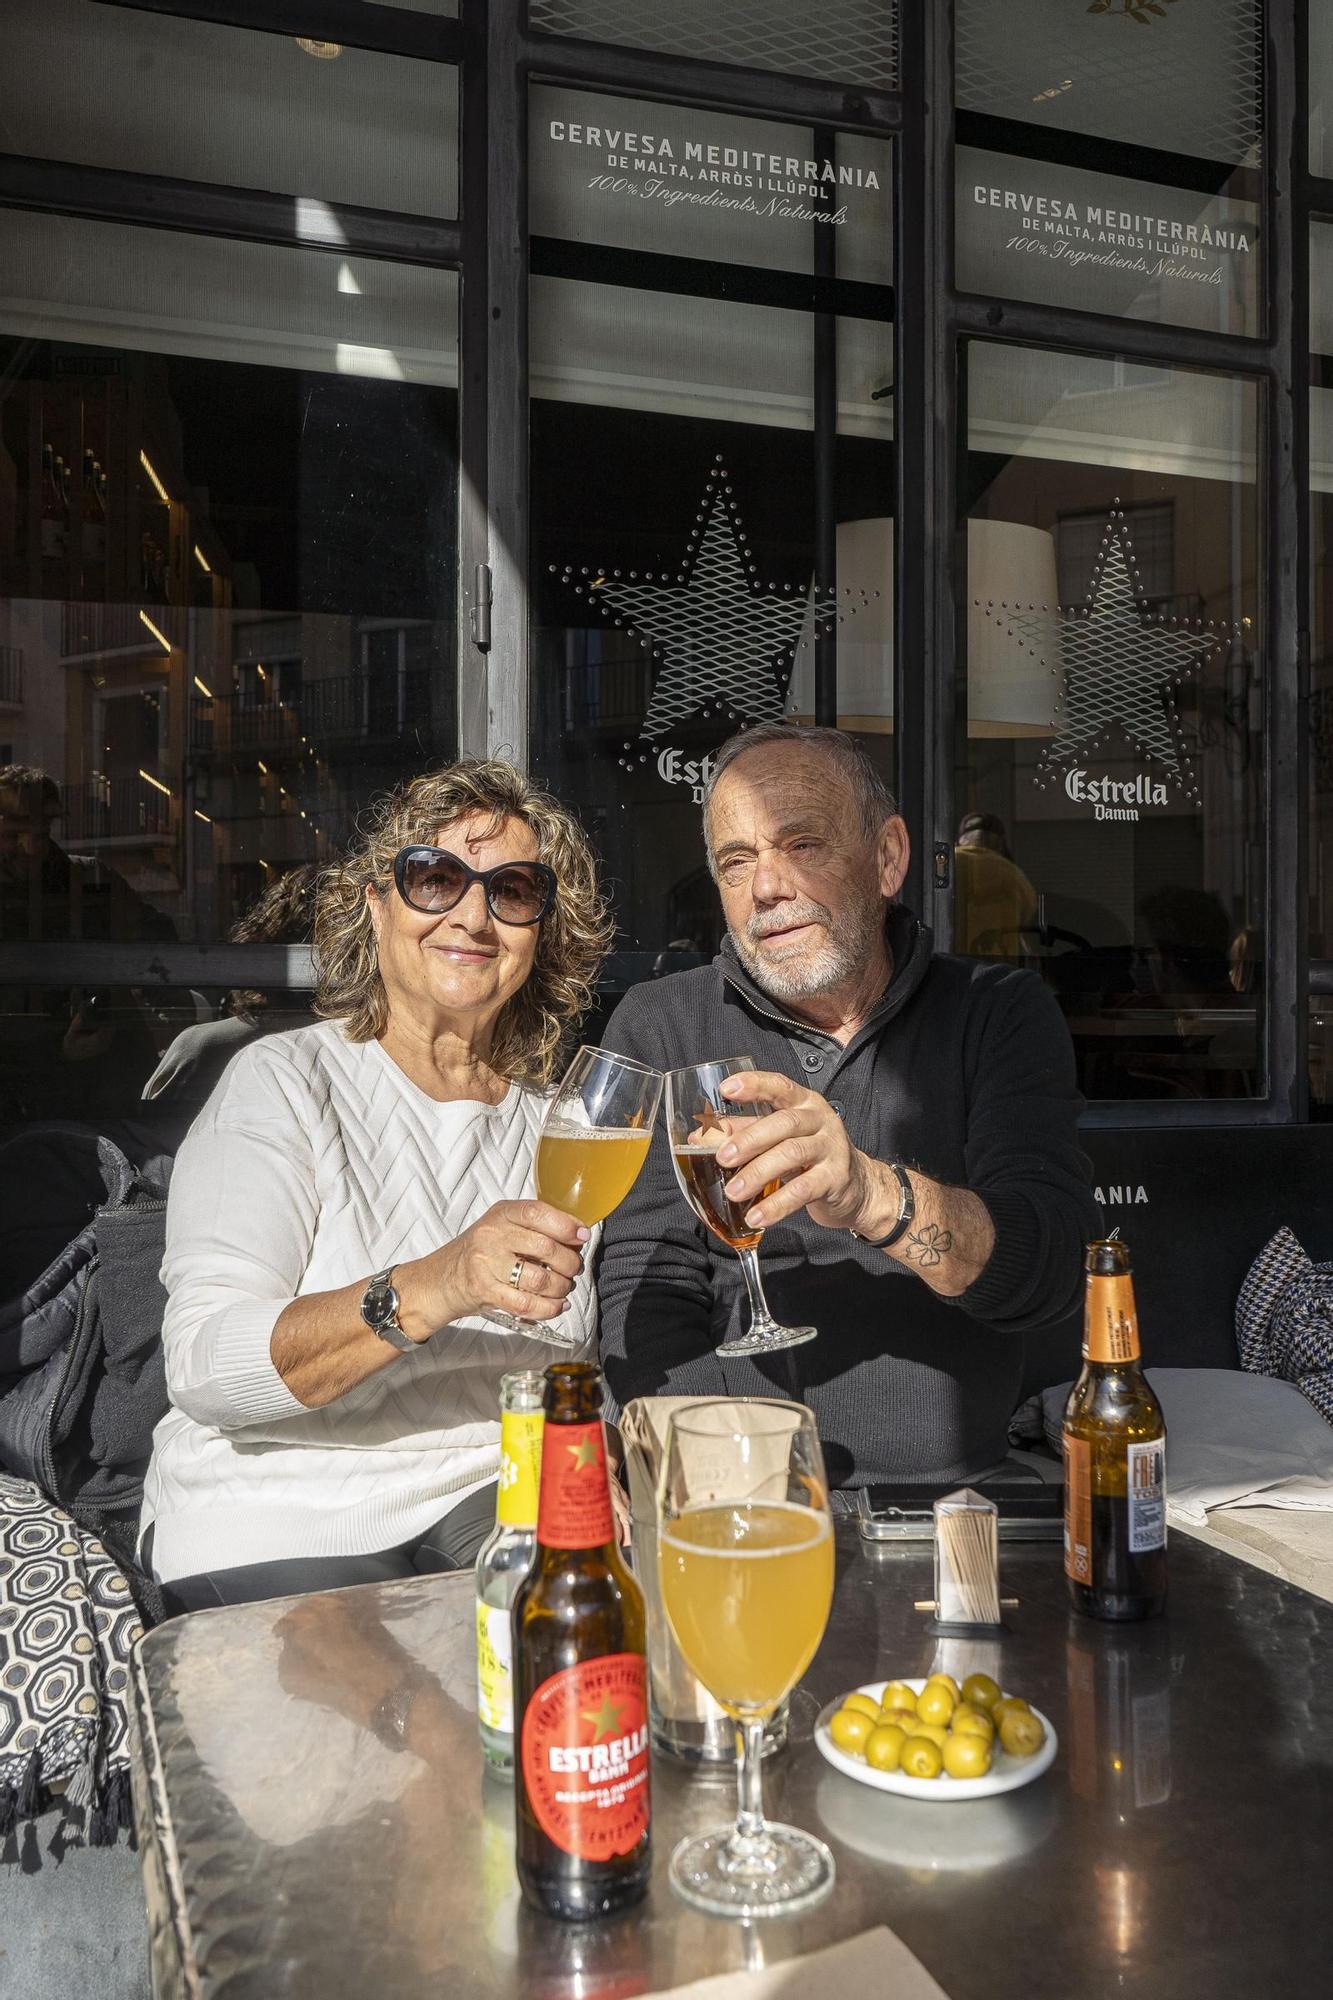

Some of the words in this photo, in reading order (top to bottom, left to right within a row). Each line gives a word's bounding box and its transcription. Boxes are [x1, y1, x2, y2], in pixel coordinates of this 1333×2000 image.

[550, 121, 674, 158] CERVESA
[685, 142, 880, 190] MEDITERRÀNIA
[608, 154, 629, 168] DE
[634, 157, 694, 181] MALTA,
[699, 168, 753, 187] ARRÒS
[758, 177, 763, 190] I
[768, 177, 829, 200] LLÚPOL
[587, 174, 638, 195] 100%
[640, 178, 757, 211] Ingredients
[756, 198, 848, 225] Naturals
[974, 185, 1078, 221] CERVESA
[1086, 206, 1249, 252] MEDITERRÀNIA
[1005, 235, 1048, 256] 100%
[1049, 239, 1147, 272] Ingredients
[1146, 257, 1223, 285] Naturals
[1022, 217, 1040, 231] DE
[1045, 221, 1095, 242] MALTA,
[1098, 232, 1144, 249] ARRÒS
[1148, 239, 1152, 251] I
[1156, 241, 1207, 261] LLÚPOL
[657, 747, 715, 785] Est
[1065, 768, 1168, 805] Estrella
[691, 785, 705, 804] D
[1093, 803, 1139, 821] Damm
[1093, 1185, 1149, 1205] ANIA
[549, 1723, 648, 1773] ESTRELLA
